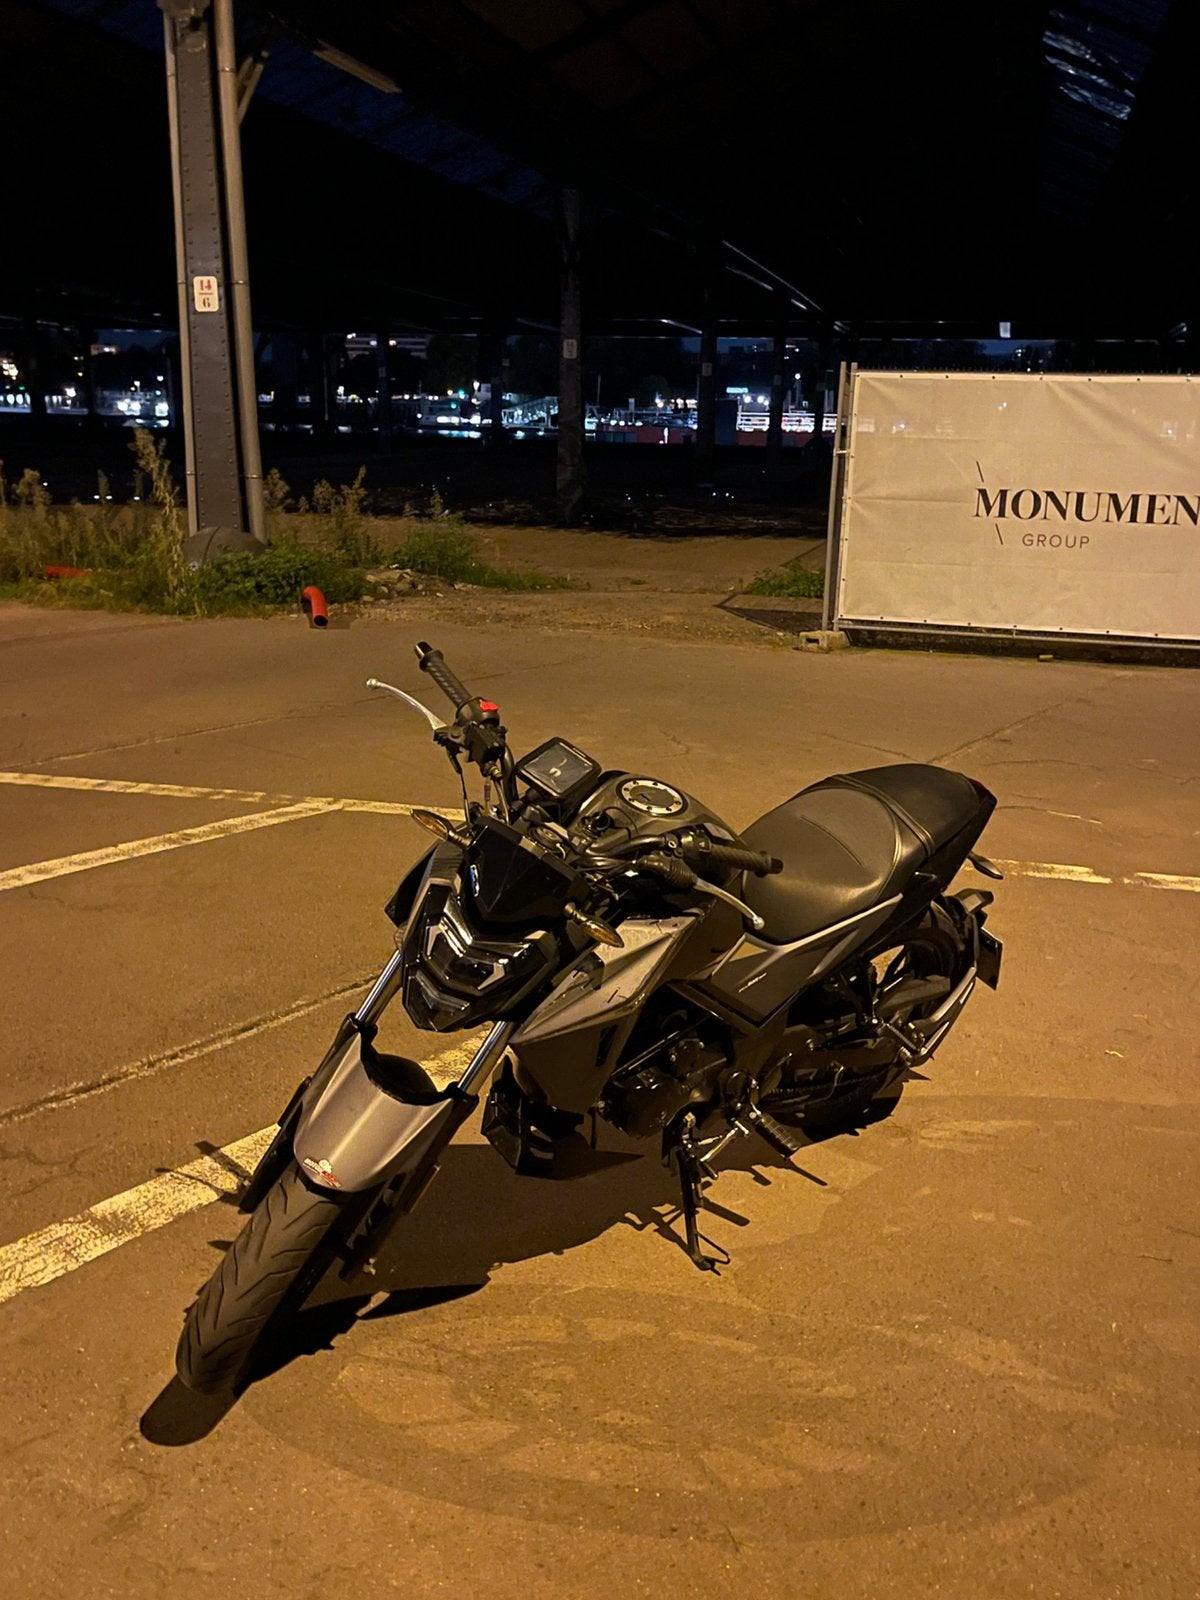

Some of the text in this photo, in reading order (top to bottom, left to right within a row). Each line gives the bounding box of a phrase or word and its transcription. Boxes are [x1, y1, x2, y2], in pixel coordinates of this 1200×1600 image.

[200, 279, 212, 291] 14
[202, 297, 211, 308] 6
[1022, 533, 1090, 549] GROUP
